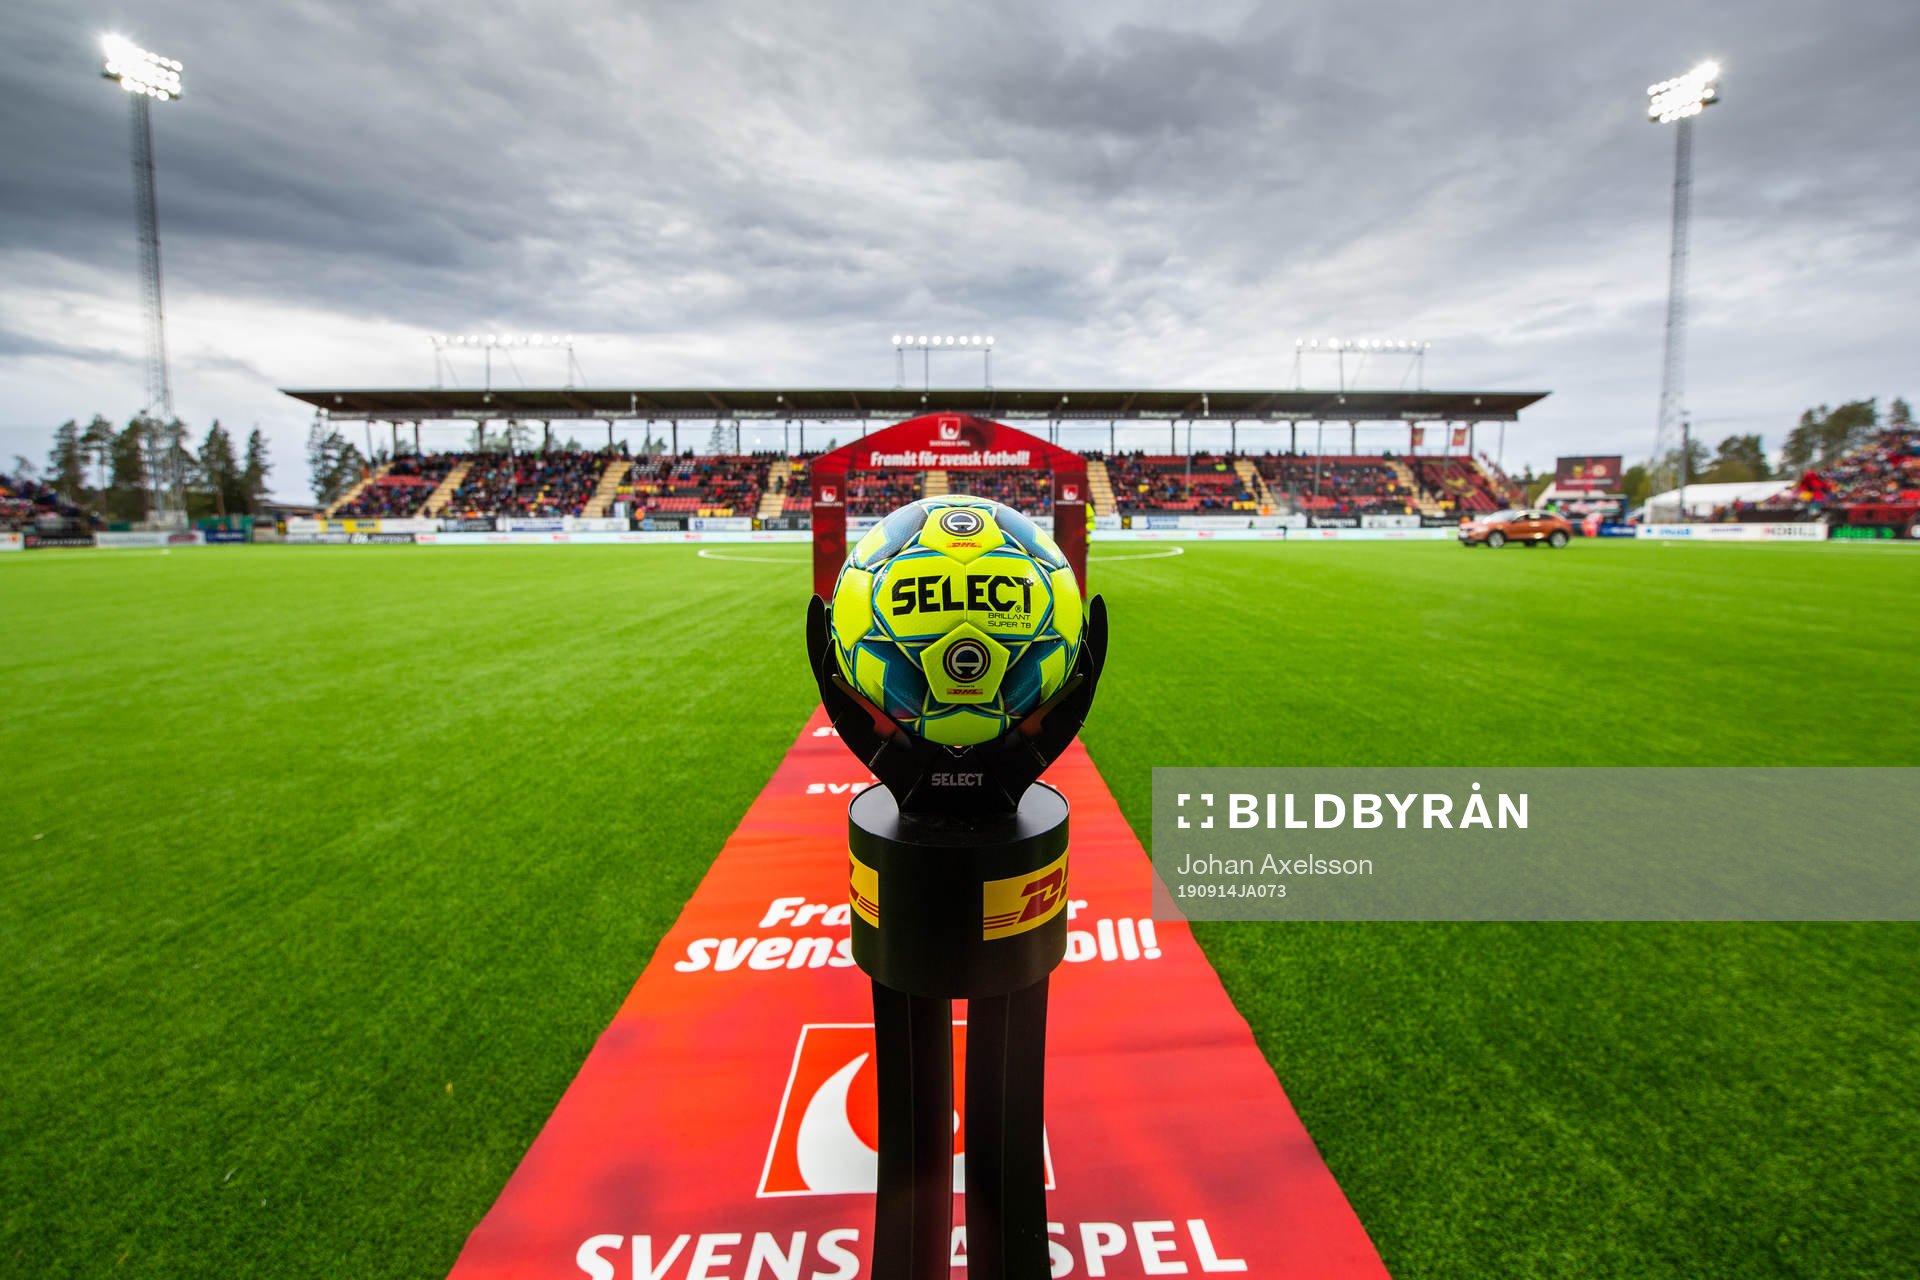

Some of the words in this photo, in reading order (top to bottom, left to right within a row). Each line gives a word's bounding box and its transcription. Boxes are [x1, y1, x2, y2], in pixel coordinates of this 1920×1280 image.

[870, 451, 917, 467] Framåt
[918, 451, 937, 467] för
[939, 451, 981, 467] svensk
[983, 451, 1030, 467] fotboll!
[892, 575, 1033, 616] SELECT
[988, 612, 1030, 620] BRILLANT
[931, 773, 984, 786] SELECT
[758, 896, 850, 928] Fra
[674, 937, 856, 972] svens
[1063, 917, 1162, 962] oll!
[576, 1228, 967, 1280] SVENS
[1047, 1219, 1248, 1279] SPEL
